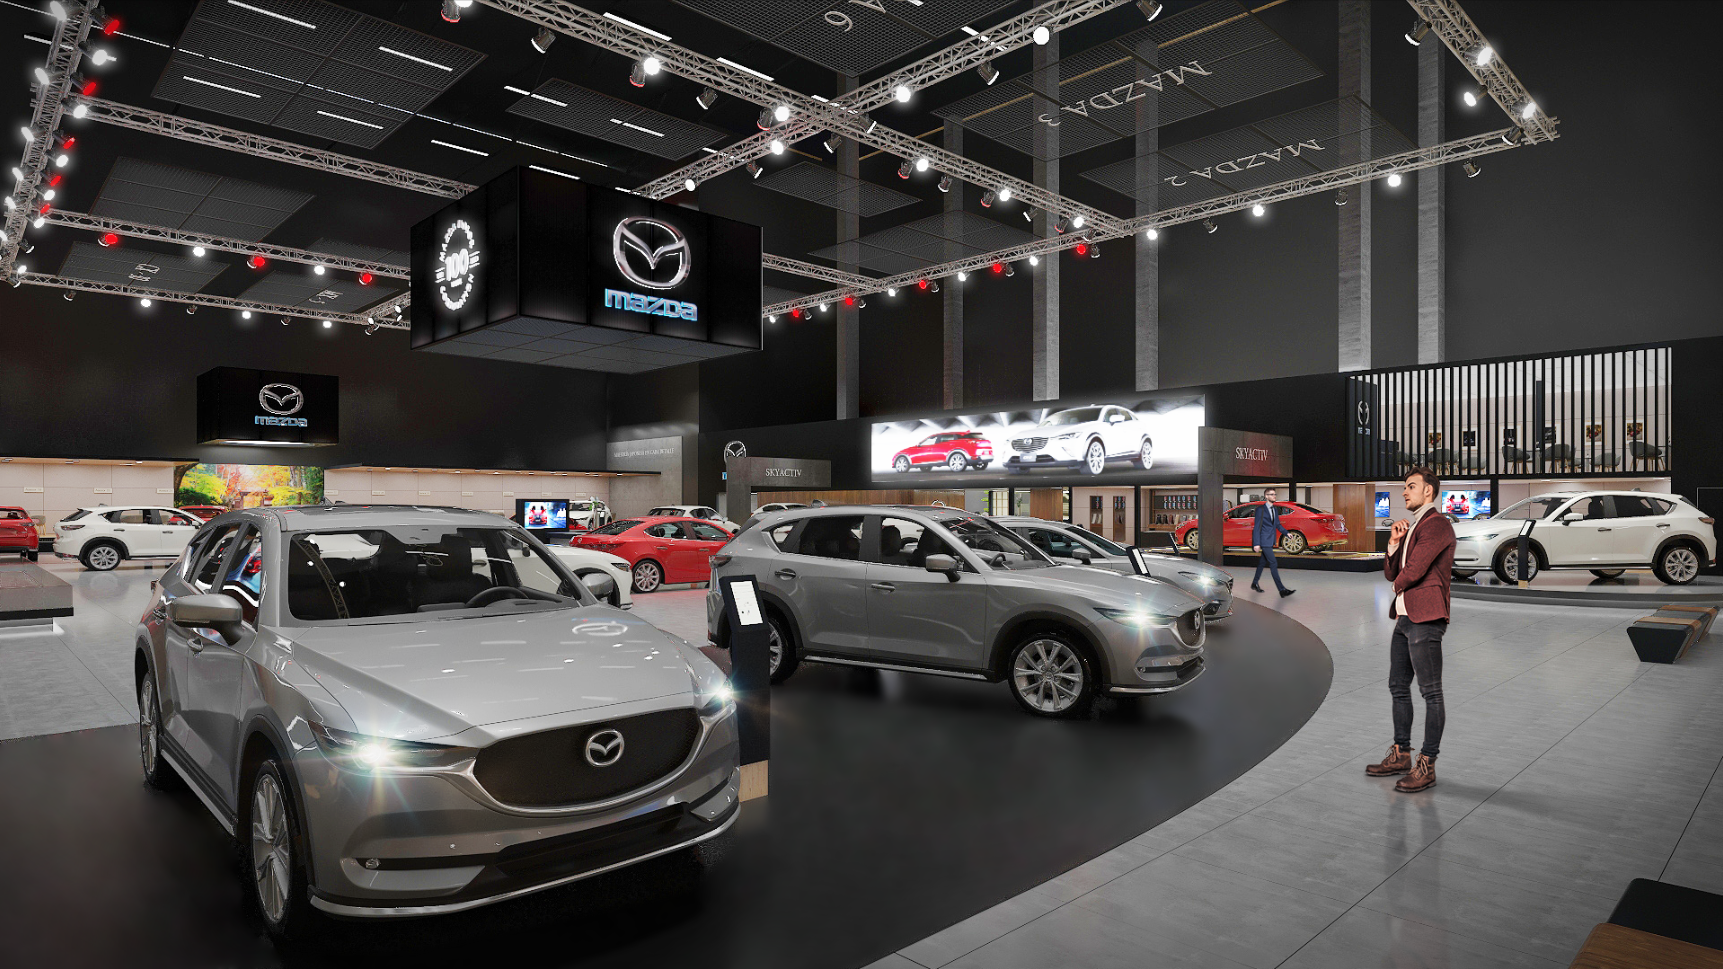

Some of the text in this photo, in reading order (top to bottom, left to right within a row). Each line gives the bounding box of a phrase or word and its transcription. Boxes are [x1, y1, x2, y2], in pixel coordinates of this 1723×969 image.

[1037, 60, 1213, 127] MAZDA 3
[1163, 139, 1326, 187] MAZDA 2
[445, 248, 470, 281] 100
[1235, 446, 1269, 461] SKYACTIV
[765, 468, 802, 478] SKYACTIV
